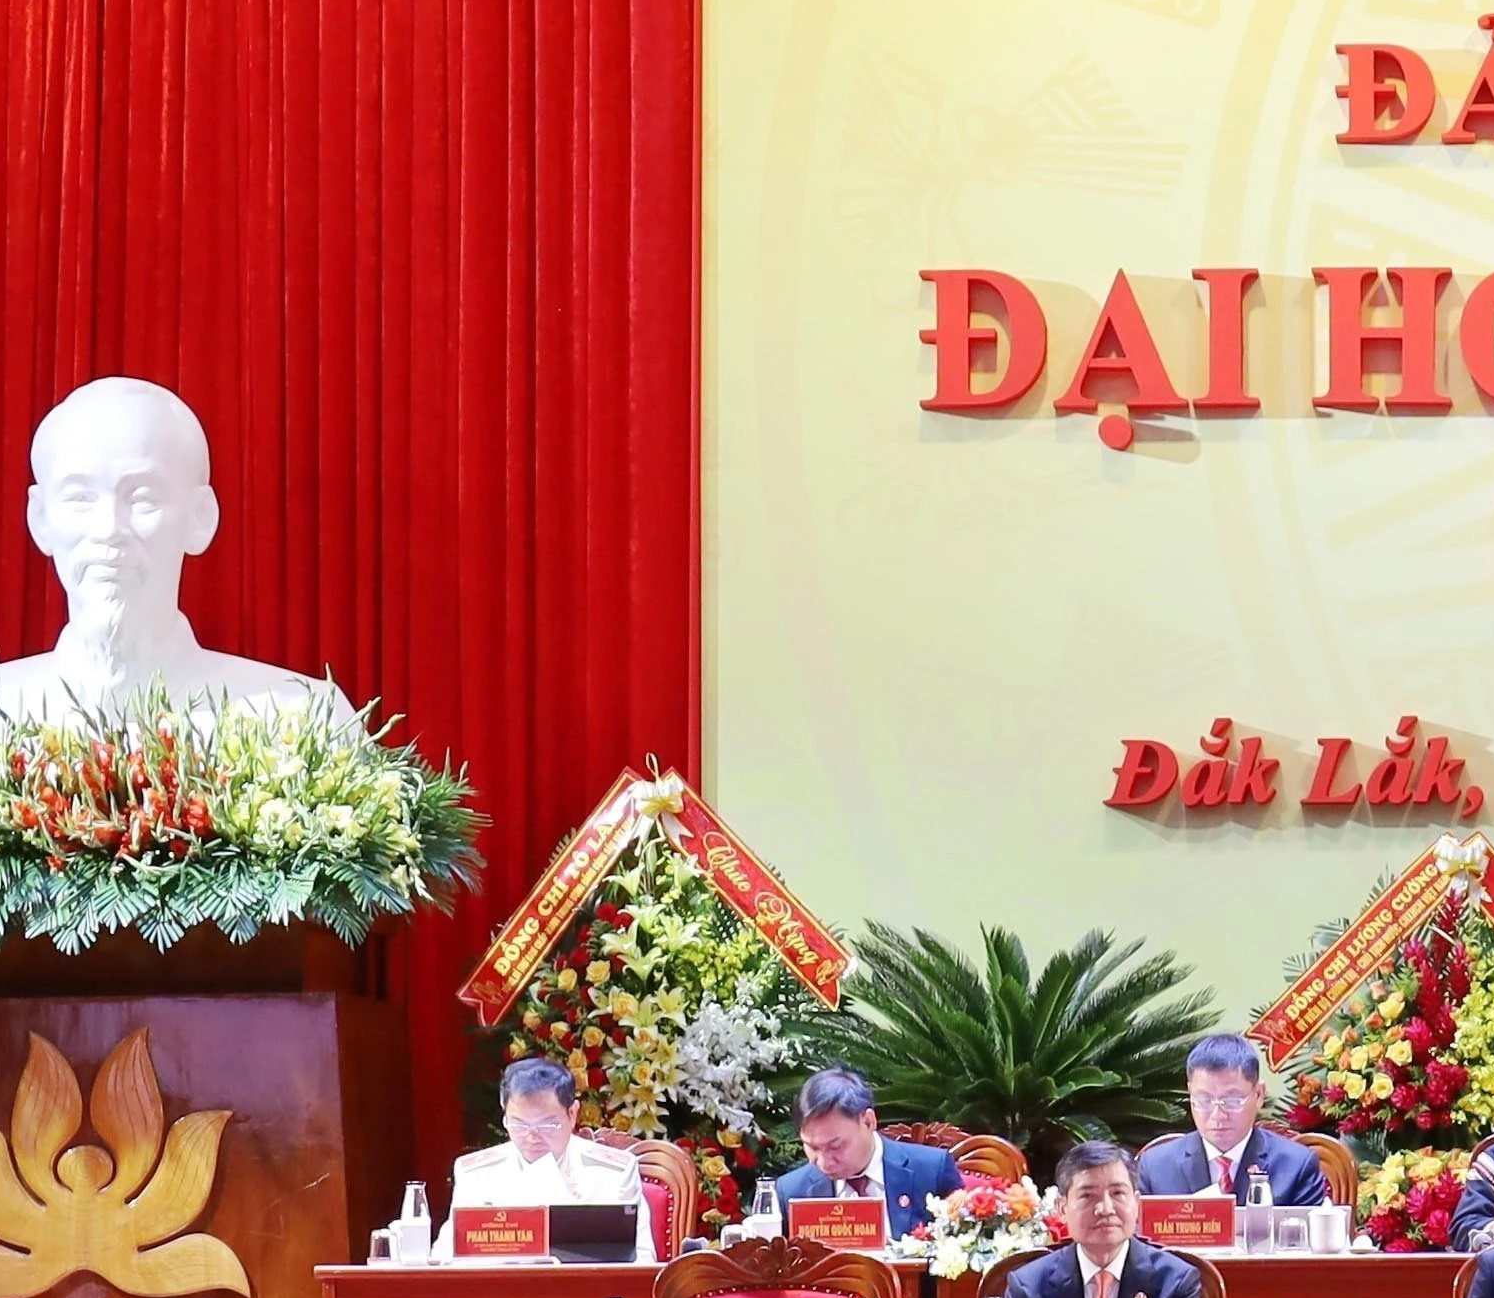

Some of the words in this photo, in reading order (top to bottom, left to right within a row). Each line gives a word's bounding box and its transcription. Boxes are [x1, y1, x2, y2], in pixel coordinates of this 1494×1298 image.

[920, 270, 1260, 450] ĐẠI
[1106, 719, 1279, 813] Đắk
[1301, 717, 1484, 819] Lắk,
[493, 916, 539, 975] ĐỒNG
[537, 875, 569, 916] CHÍ
[1284, 978, 1324, 1020] ĐỒNG
[1323, 950, 1350, 980] CHÍ
[1345, 908, 1392, 957] LƯƠNG
[1391, 863, 1442, 910] CƯỜNG
